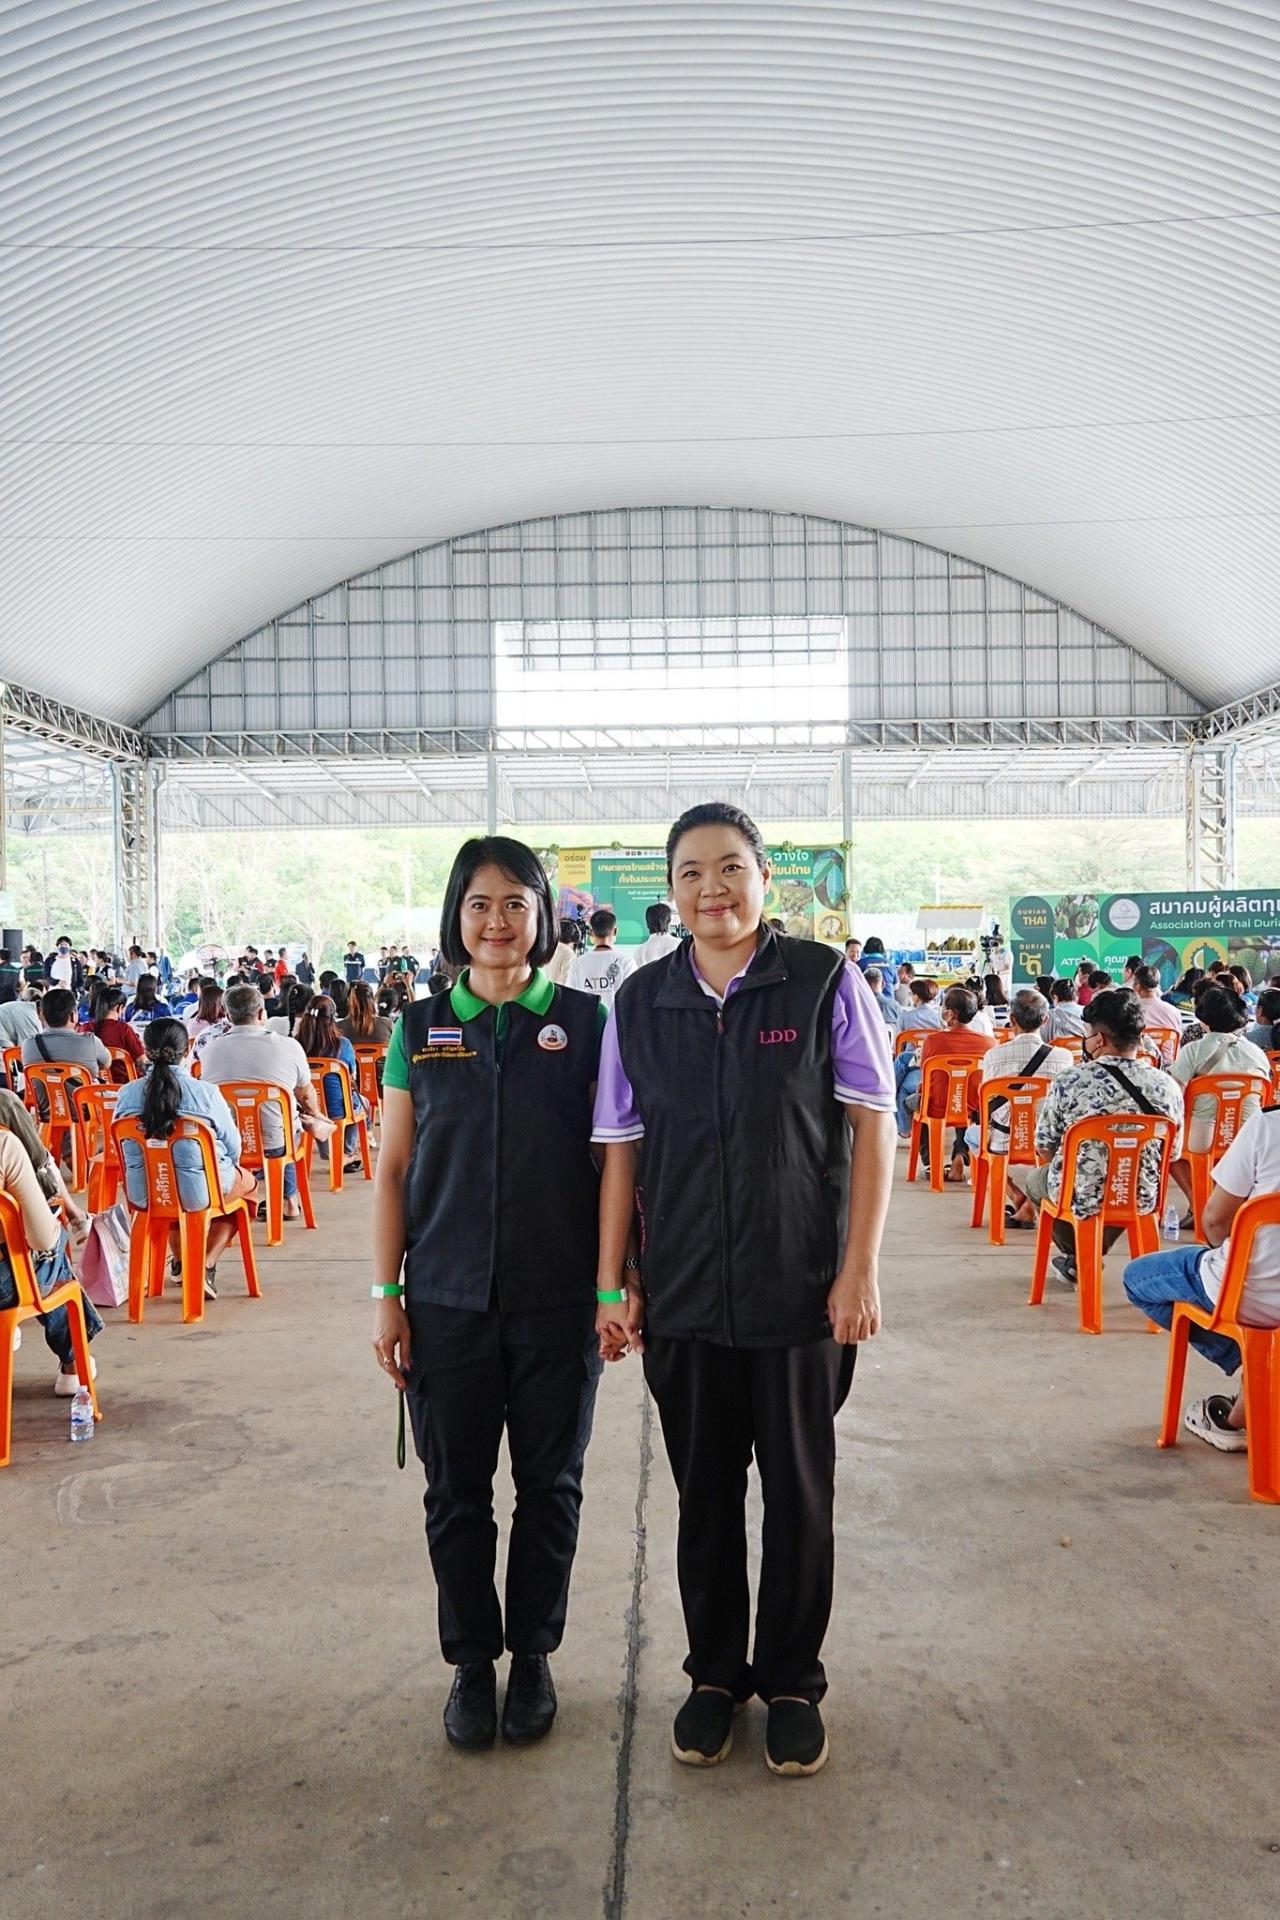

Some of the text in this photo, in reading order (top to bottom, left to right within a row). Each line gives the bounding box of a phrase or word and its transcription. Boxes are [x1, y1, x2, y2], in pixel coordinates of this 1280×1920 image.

[1023, 916, 1047, 926] THAI
[1150, 920, 1211, 929] Association
[1213, 919, 1224, 928] of
[1227, 918, 1251, 928] Thai
[585, 976, 616, 989] ATDP
[759, 1029, 797, 1044] LDD
